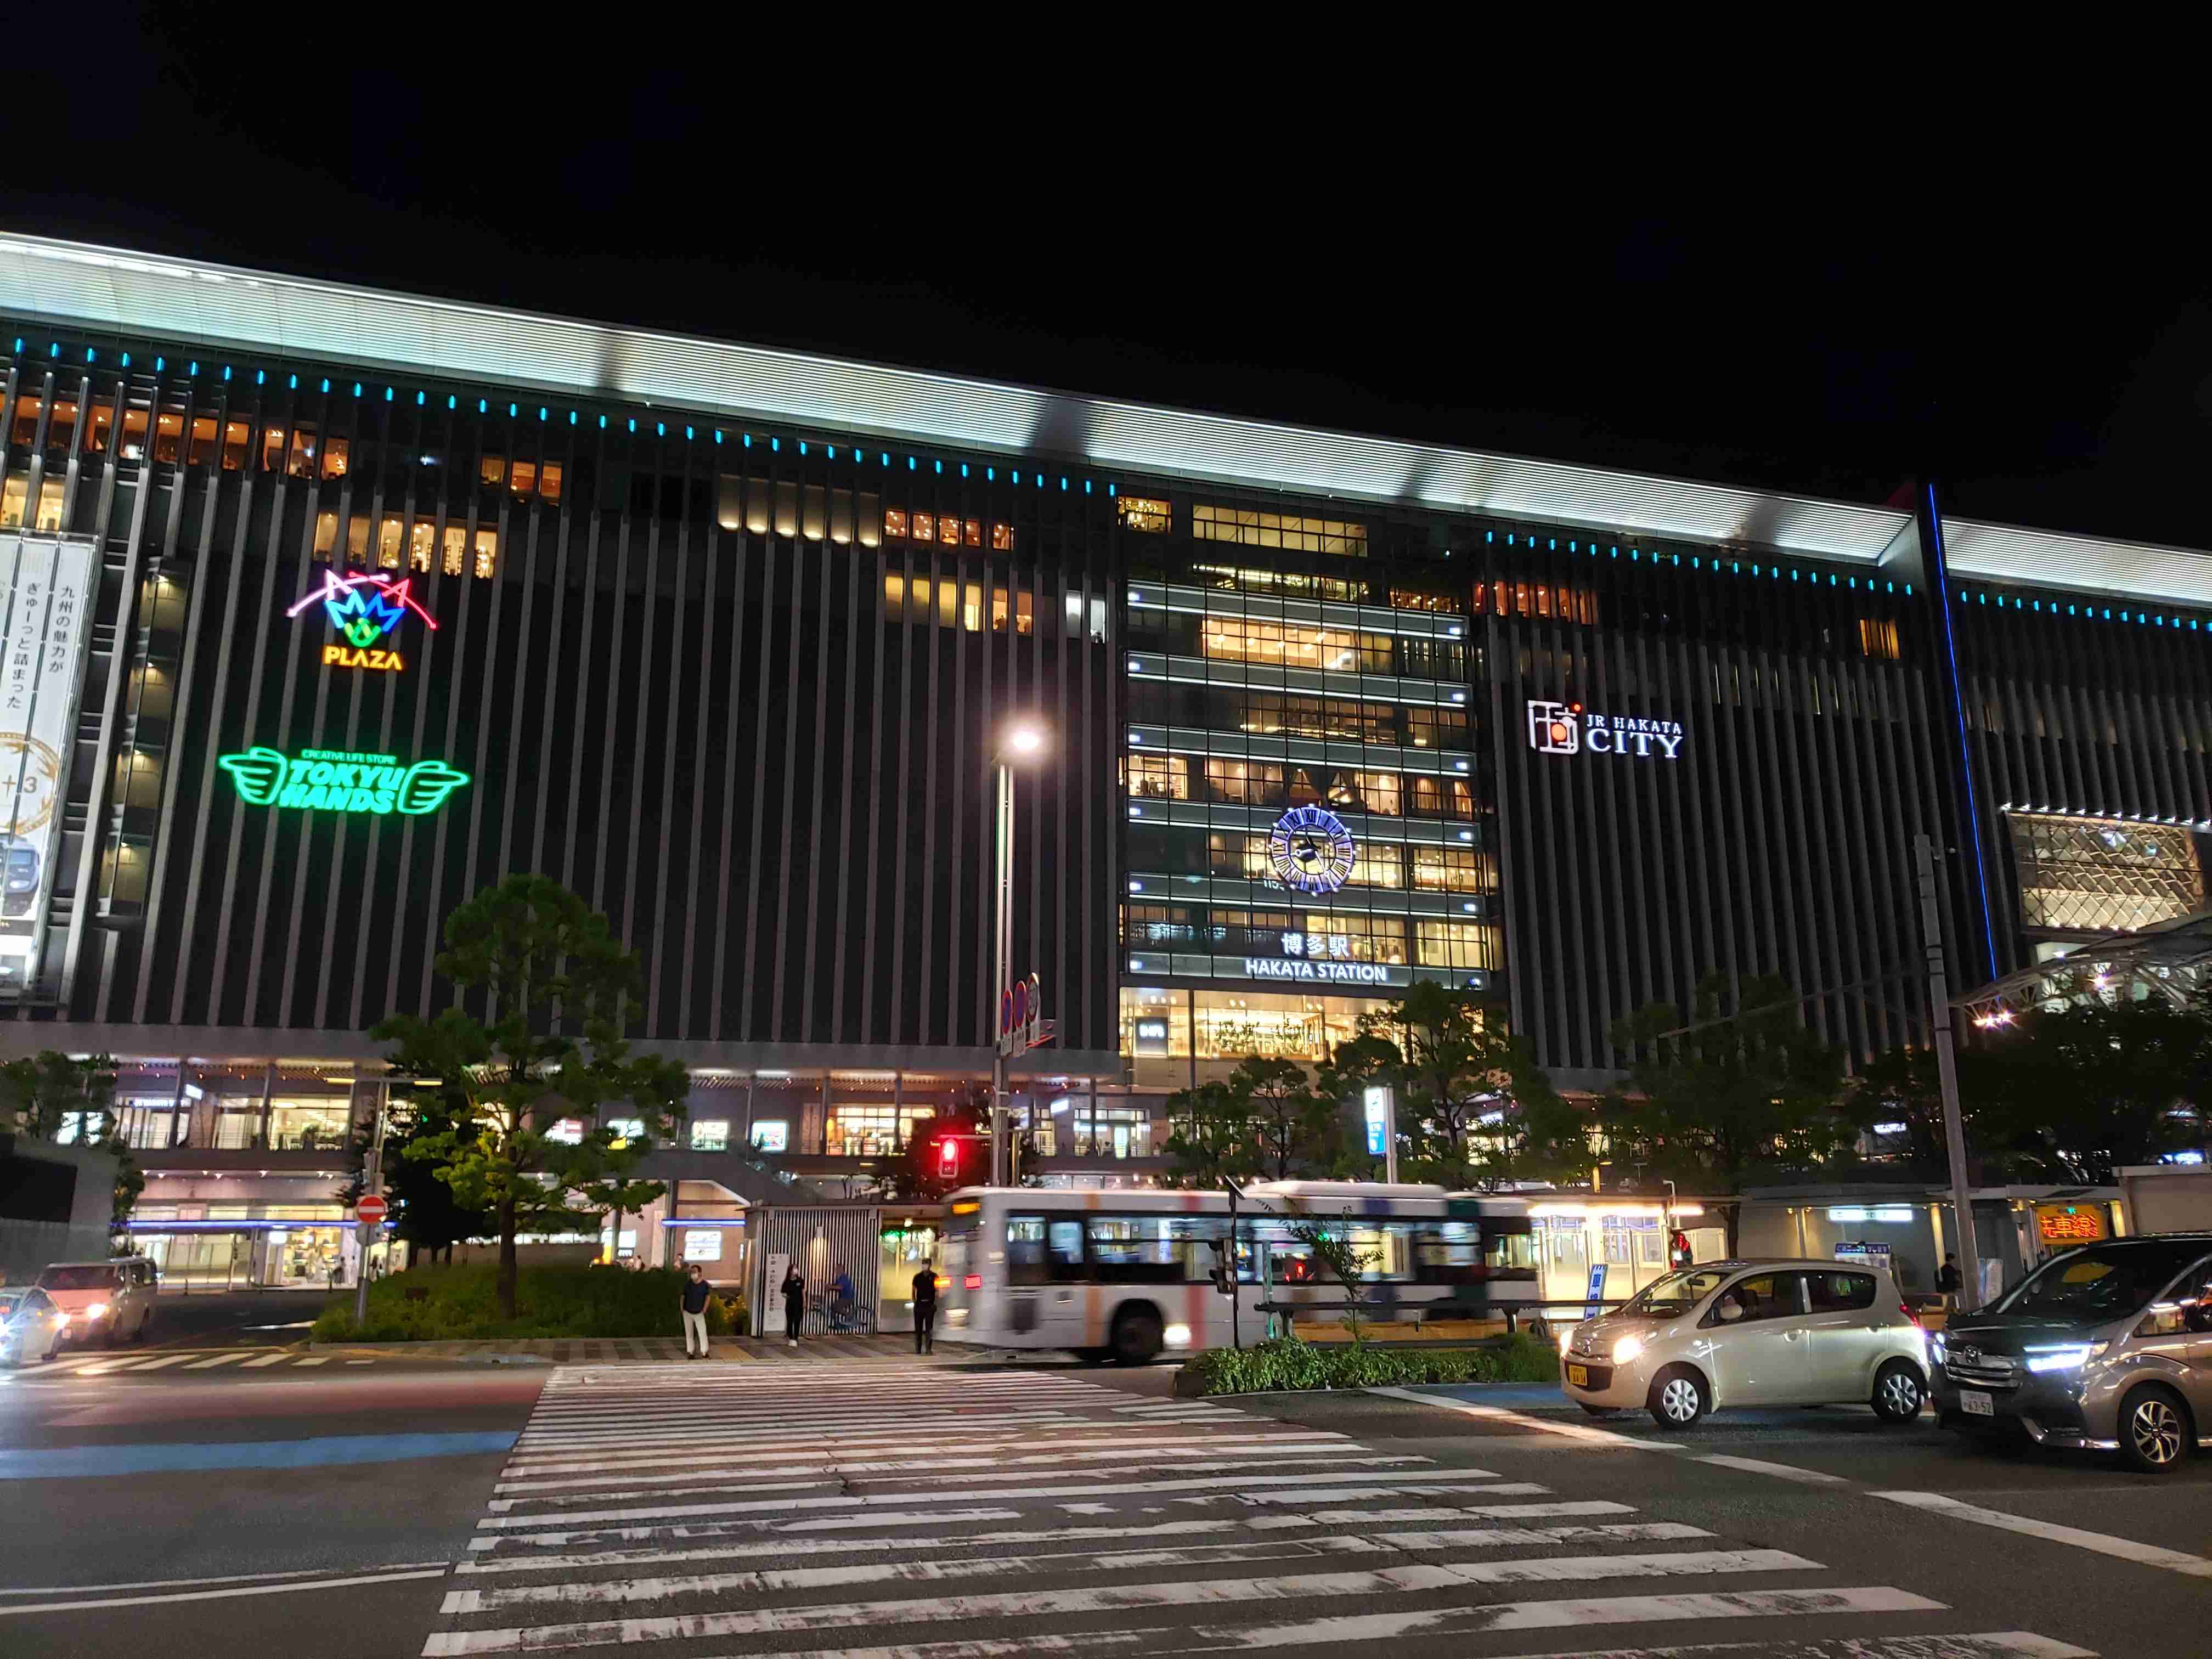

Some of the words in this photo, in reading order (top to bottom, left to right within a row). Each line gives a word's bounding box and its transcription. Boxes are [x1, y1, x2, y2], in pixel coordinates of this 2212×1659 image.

[48, 585, 75, 674] 九州の魅力が
[324, 645, 402, 671] PLAZA
[1587, 714, 1605, 727] JR
[1613, 716, 1681, 735] HAKATA
[1586, 728, 1683, 758] CITY
[290, 759, 406, 791] TOKYU
[278, 783, 396, 814] HANDS
[1281, 932, 1350, 957] 博多駅
[1245, 959, 1313, 980] HAKATA
[1318, 963, 1387, 981] STATION
